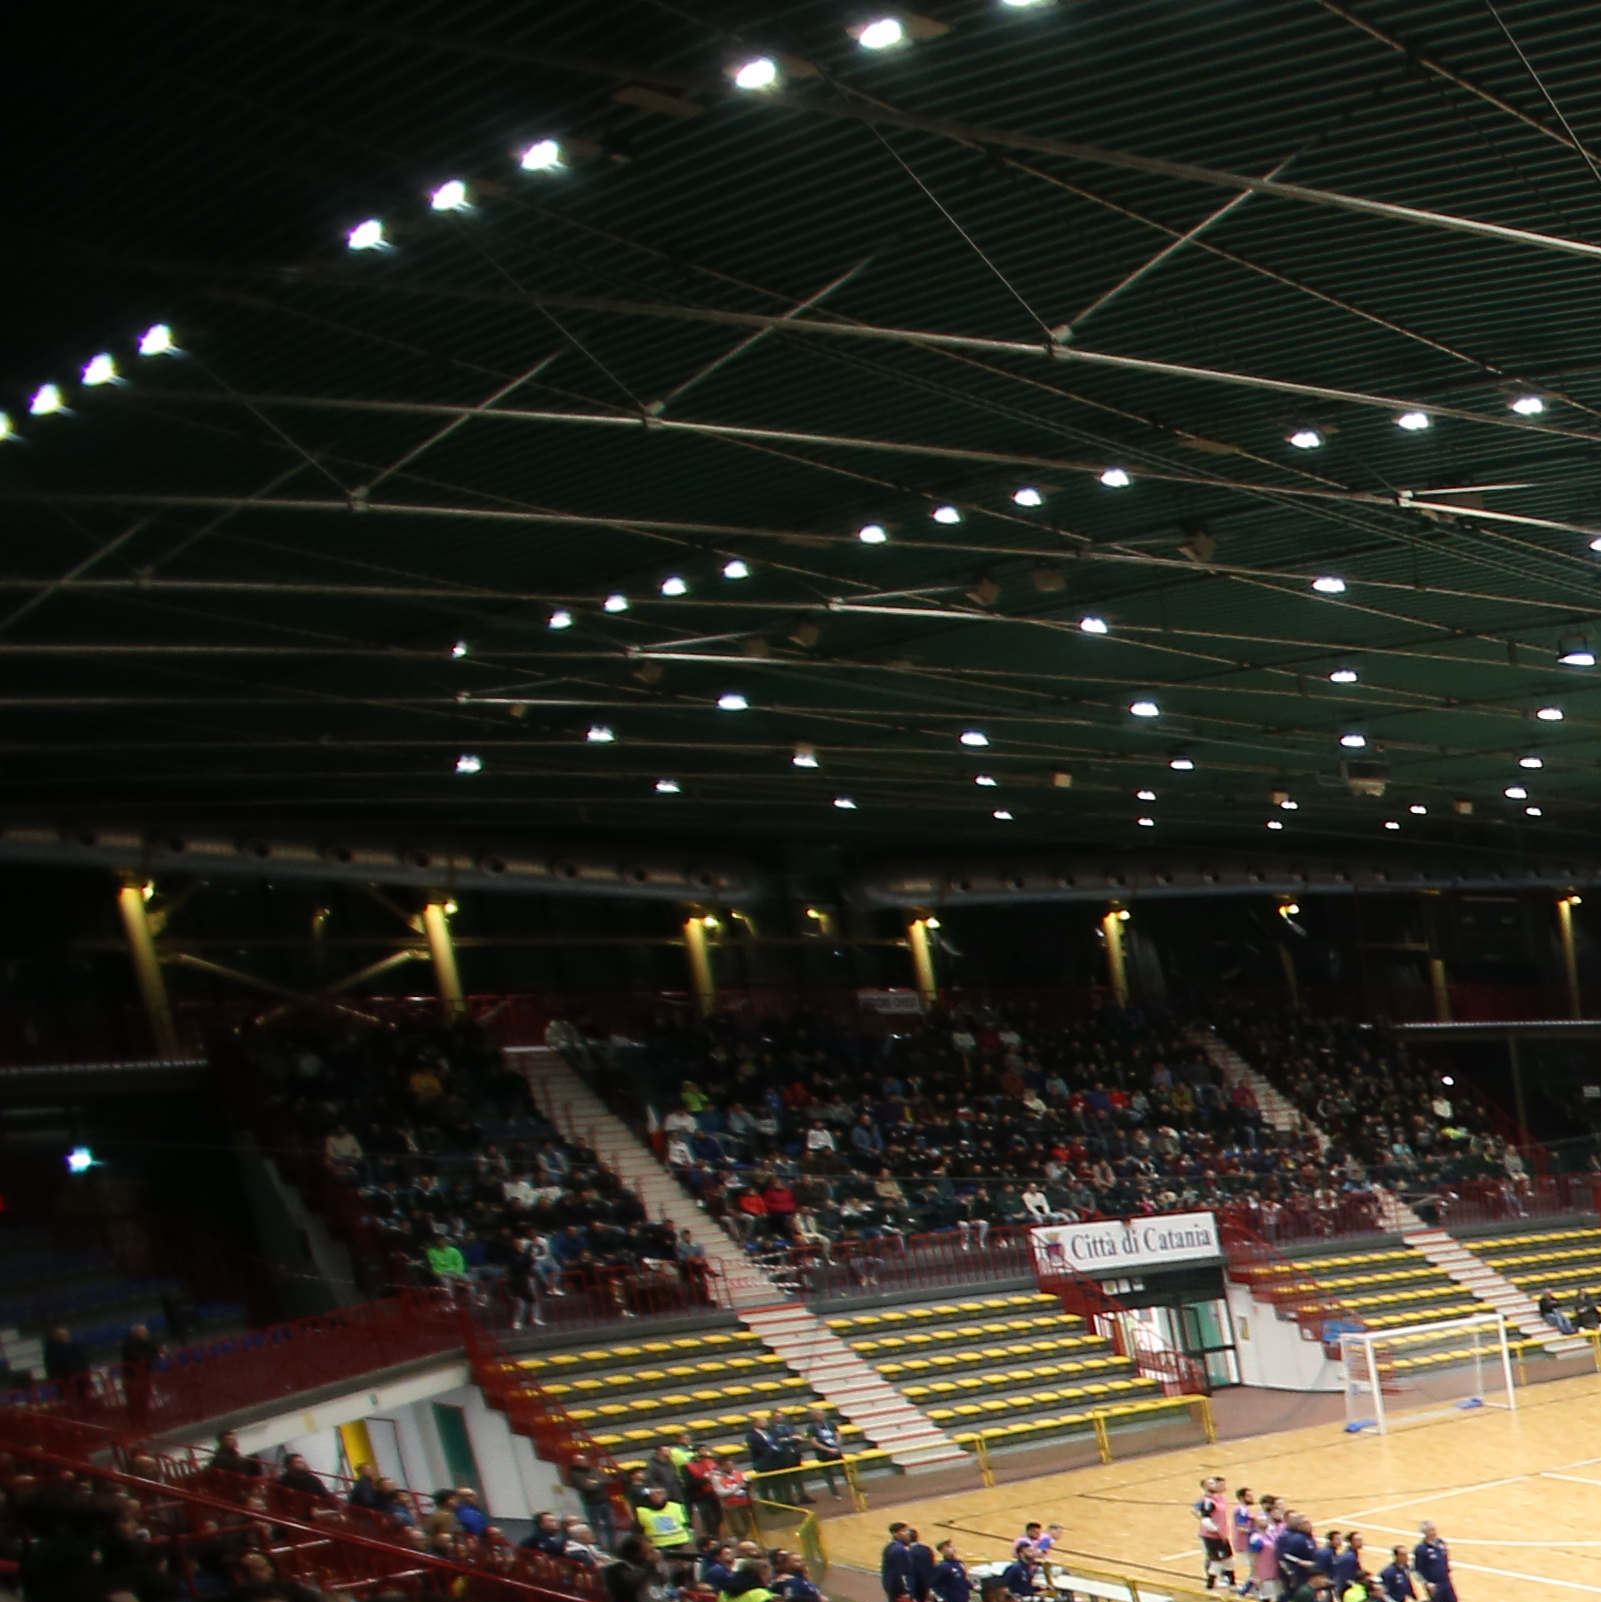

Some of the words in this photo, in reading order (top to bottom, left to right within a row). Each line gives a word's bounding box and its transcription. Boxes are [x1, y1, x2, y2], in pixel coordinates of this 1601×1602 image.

[1071, 1231, 1117, 1261] Città
[1121, 1227, 1140, 1255] di
[1144, 1224, 1211, 1252] Catania
